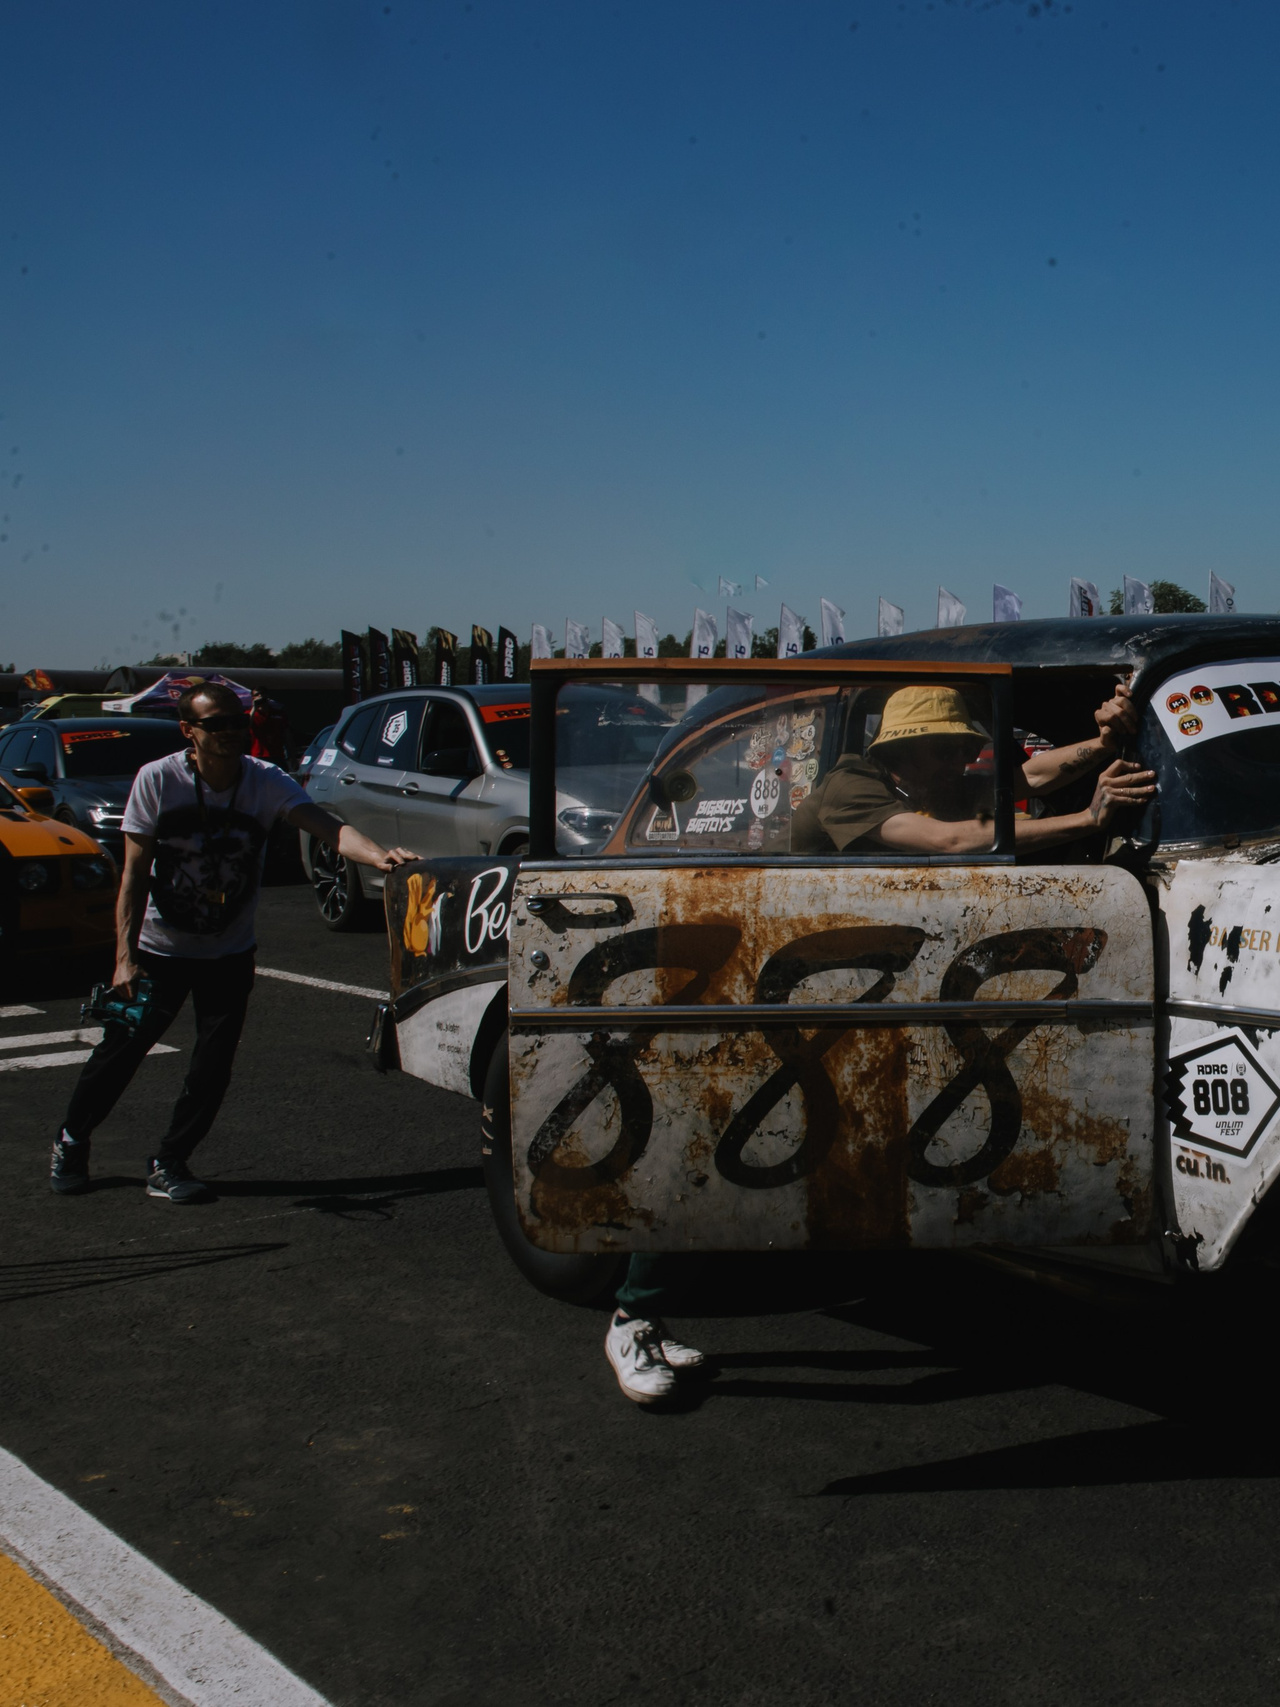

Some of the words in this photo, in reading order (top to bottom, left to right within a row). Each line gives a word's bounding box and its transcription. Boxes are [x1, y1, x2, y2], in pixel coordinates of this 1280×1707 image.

[754, 779, 779, 800] 888
[695, 799, 748, 816] BIGBOYS
[685, 816, 735, 833] BIGTOYS
[528, 924, 1108, 1190] 888
[1197, 1064, 1228, 1075] RDRC
[1192, 1078, 1250, 1115] 808
[1220, 1128, 1241, 1136] FEST
